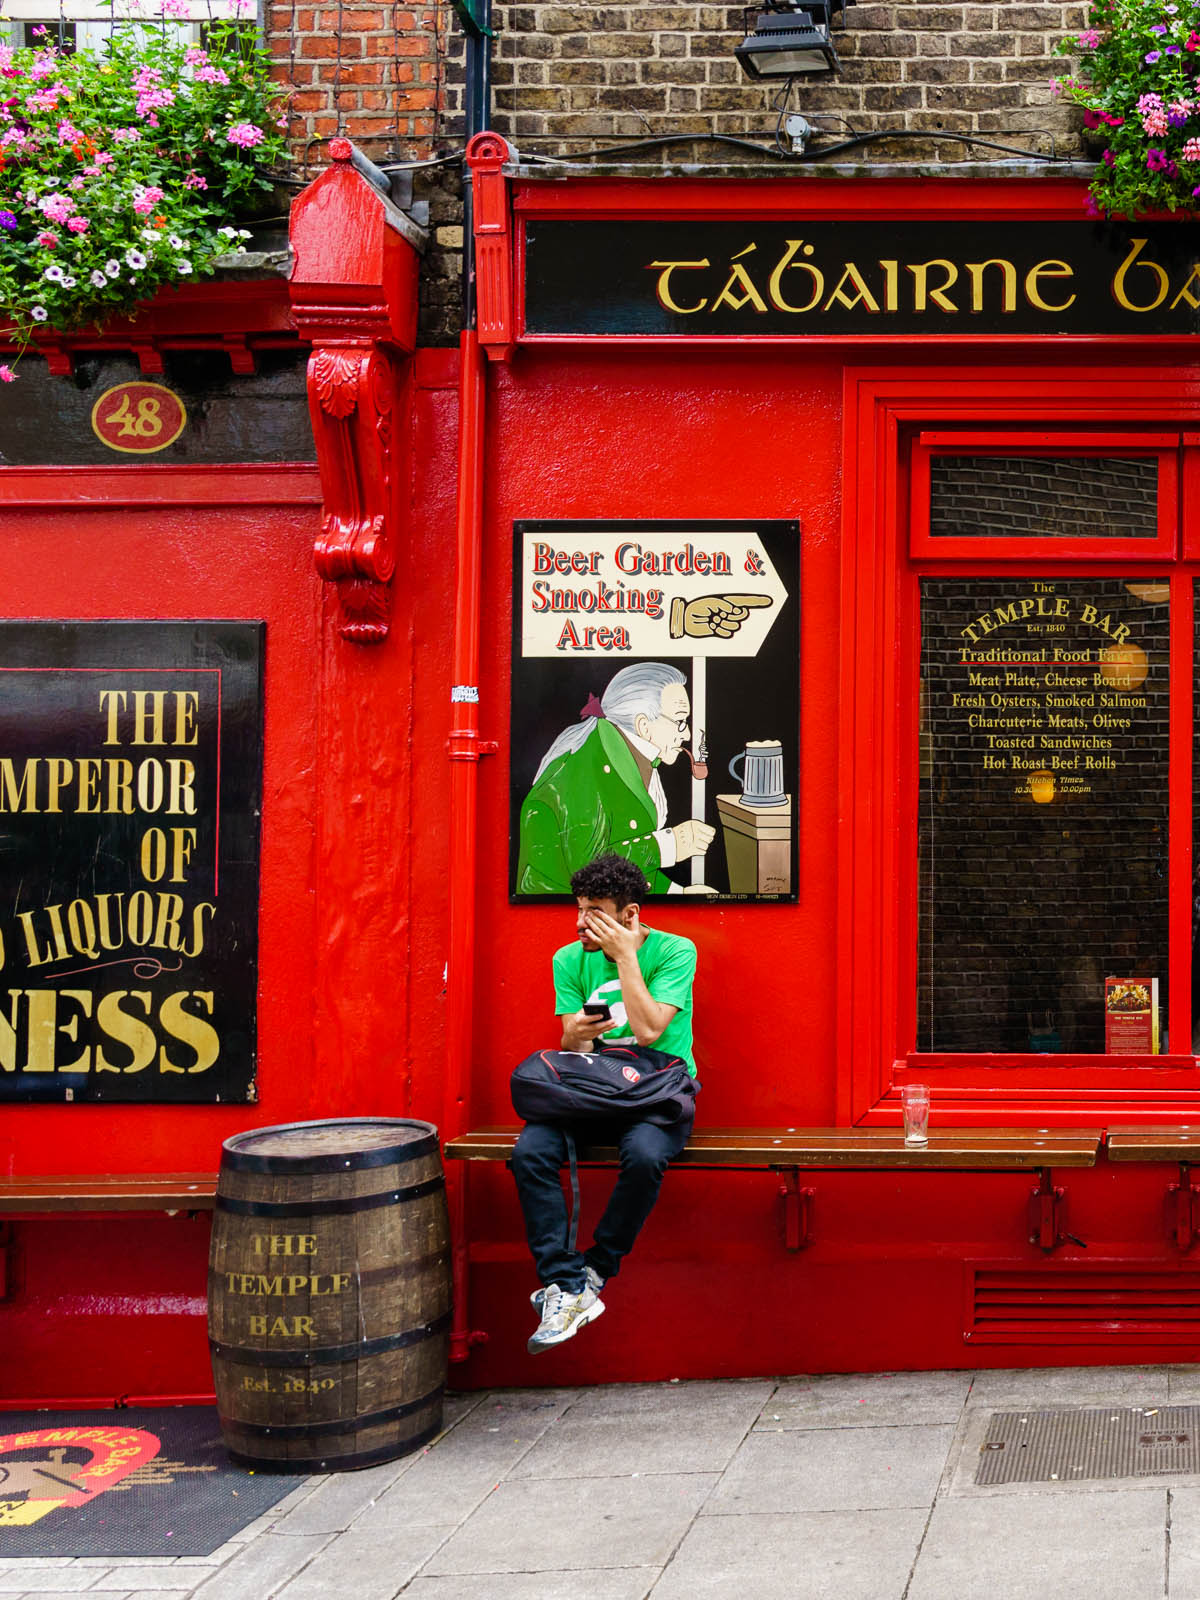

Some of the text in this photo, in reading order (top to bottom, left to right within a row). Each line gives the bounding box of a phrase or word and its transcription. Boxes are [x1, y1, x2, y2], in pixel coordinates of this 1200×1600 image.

[106, 393, 163, 437] 48
[531, 542, 767, 576] Beer Garden &
[1032, 582, 1055, 593] The
[531, 580, 665, 619] Smoking
[960, 598, 1131, 646] TEMPLE BAR
[556, 618, 632, 650] Area
[959, 648, 1046, 662] Traditional
[1054, 648, 1090, 662] Food
[969, 672, 1131, 688] Meat Plate, Cheese Board
[952, 693, 1146, 712] Fresh Oysters, Smoked Salmon
[100, 691, 199, 745] THE
[968, 713, 1131, 730] Charcuterie Meats, Olives
[987, 735, 1112, 749] Toasted Sandwiches
[983, 755, 1116, 769] Hot Roast Beef Rolls
[141, 827, 197, 883] OF
[17, 890, 217, 968] LIQUORS
[252, 1234, 318, 1256] THE
[250, 1315, 318, 1337] BAR
